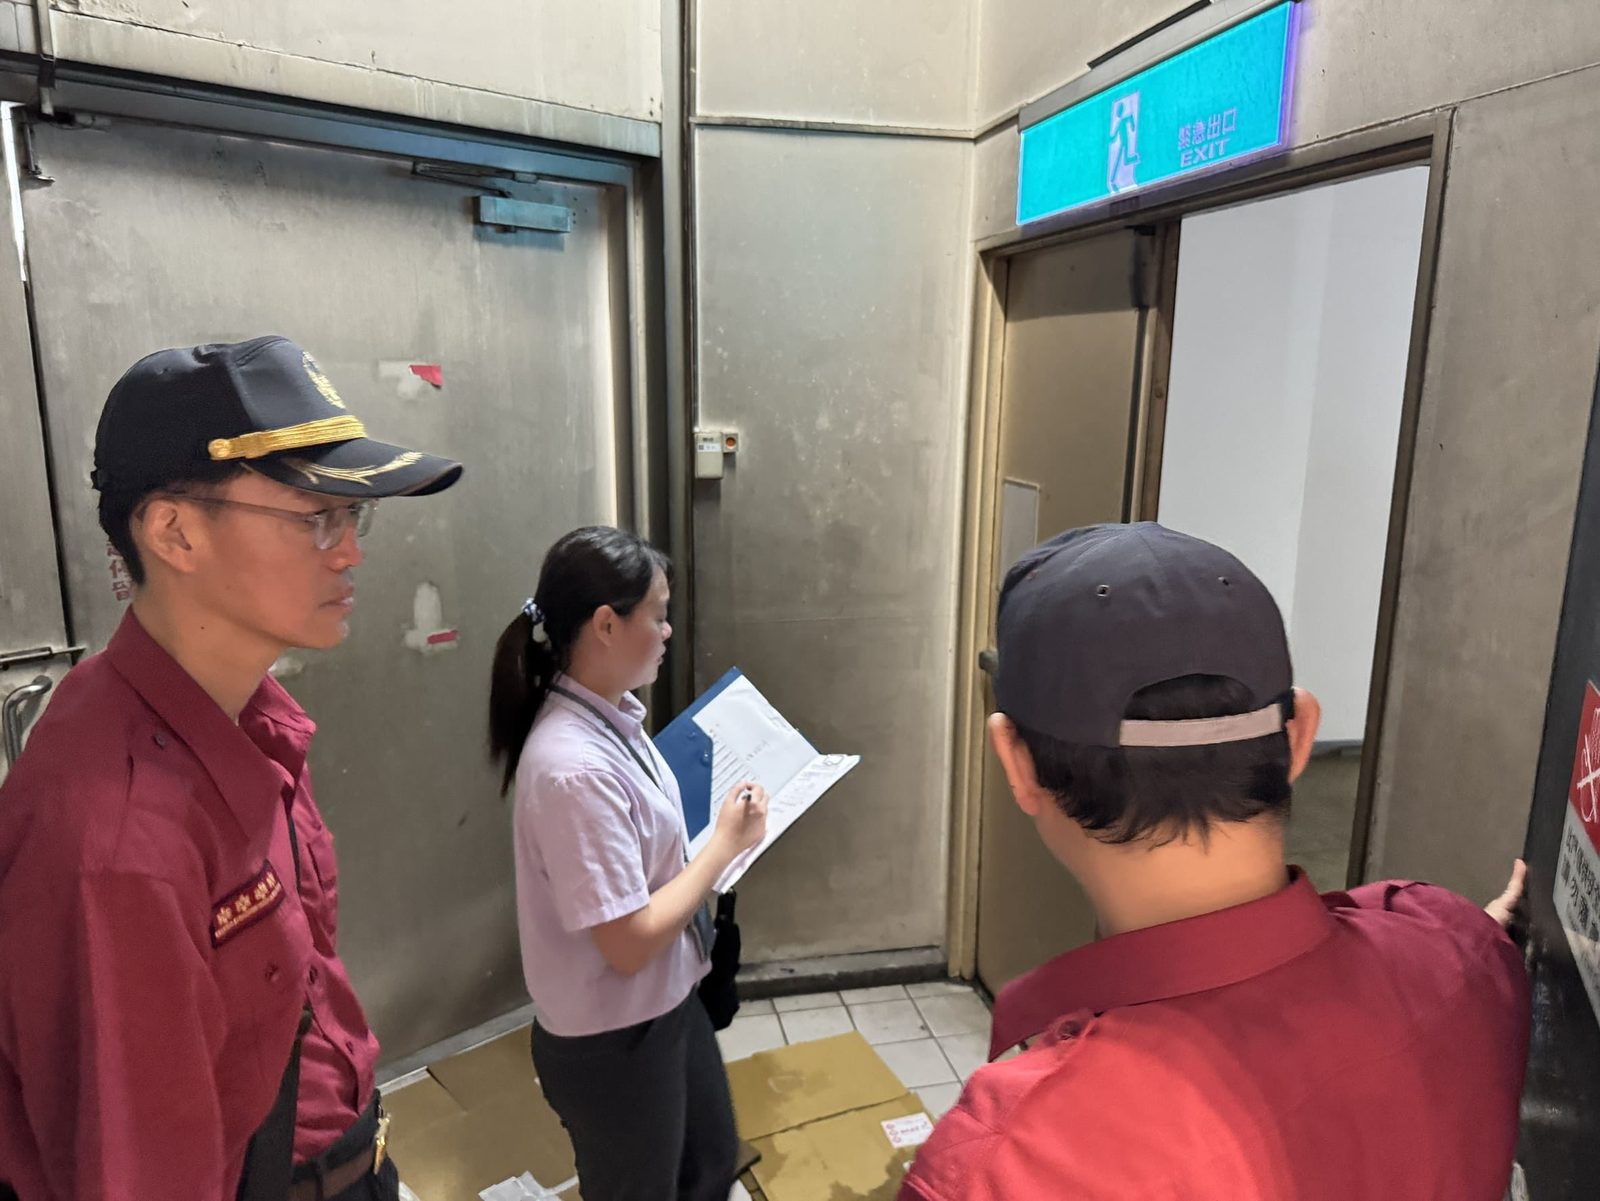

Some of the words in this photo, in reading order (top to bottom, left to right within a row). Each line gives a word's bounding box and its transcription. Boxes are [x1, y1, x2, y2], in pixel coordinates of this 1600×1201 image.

[1179, 107, 1236, 149] 緊急出口
[1181, 139, 1230, 167] EXIT
